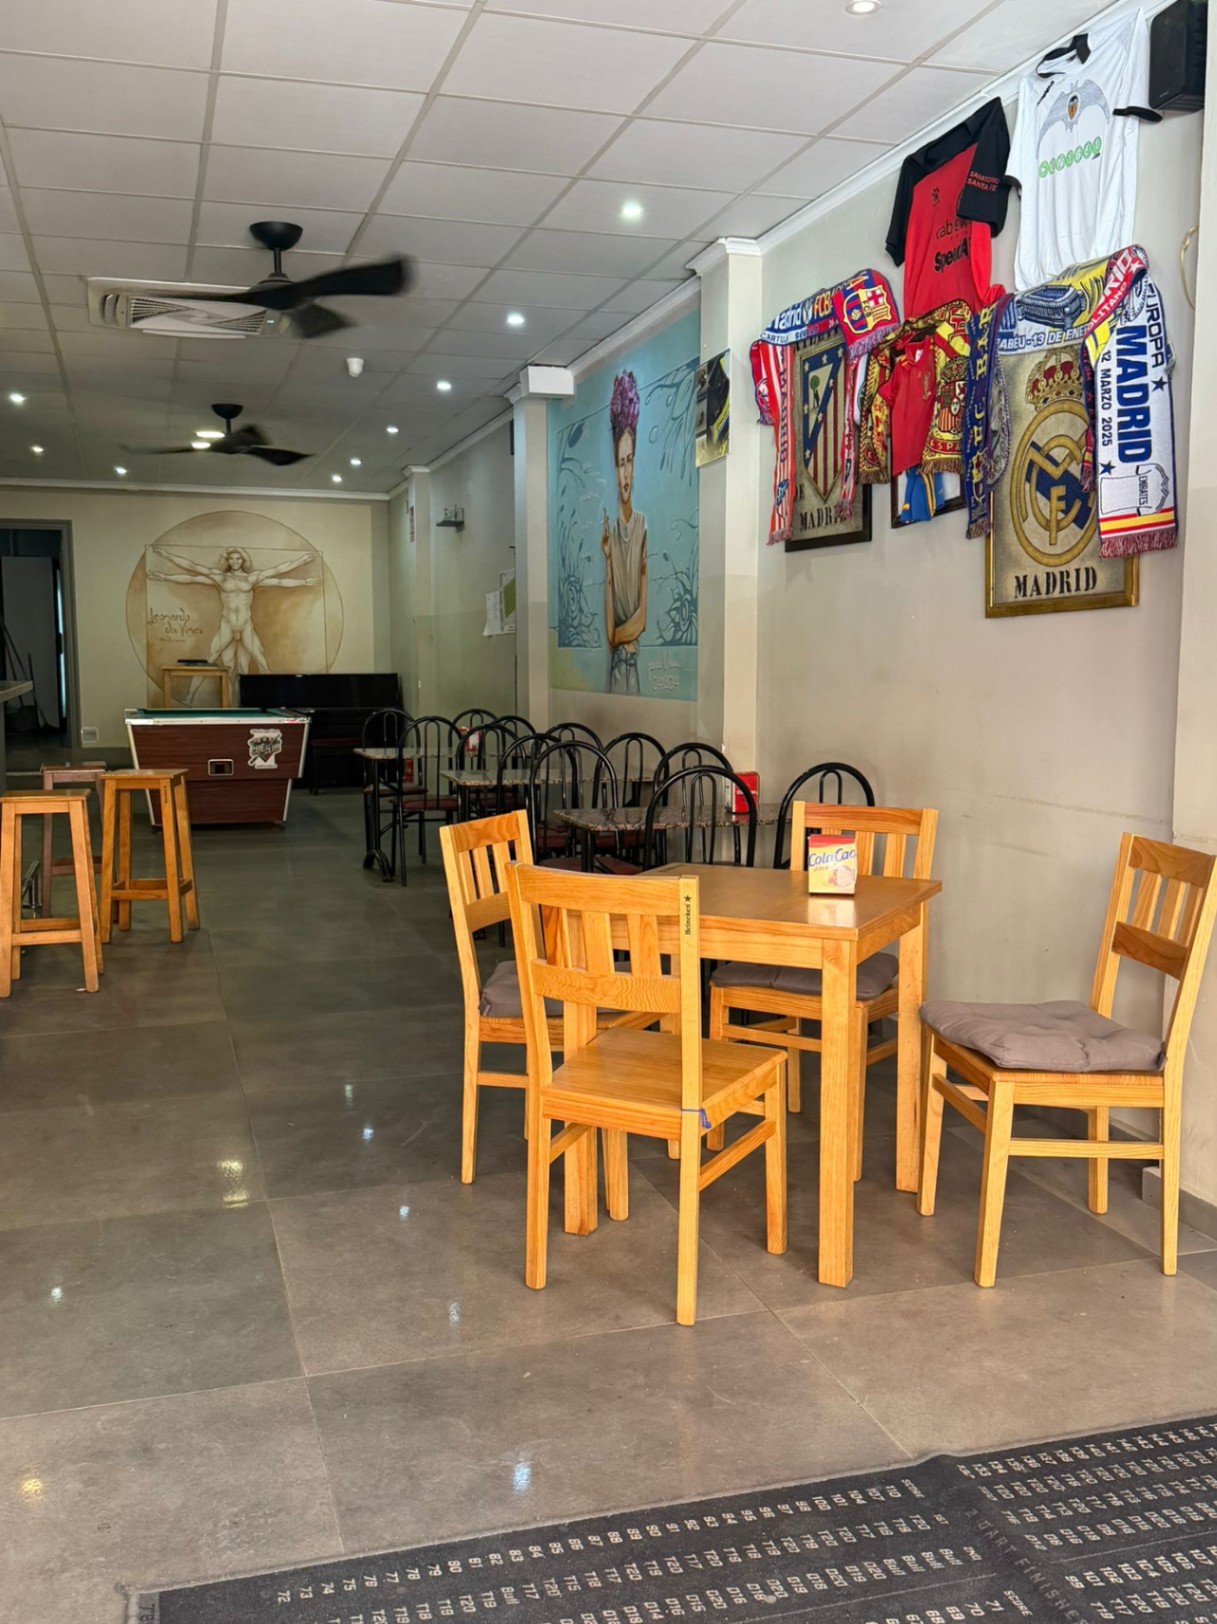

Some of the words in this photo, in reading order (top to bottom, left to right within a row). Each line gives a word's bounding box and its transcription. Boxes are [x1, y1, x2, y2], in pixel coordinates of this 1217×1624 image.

[1047, 330, 1063, 344] DE
[1101, 368, 1113, 411] MARZO
[1116, 324, 1153, 463] MADRID
[1101, 416, 1113, 447] 2025
[1014, 566, 1098, 599] MADRID
[684, 902, 692, 936] Heineken
[758, 1506, 776, 1519] 96
[780, 1536, 801, 1553] T20
[830, 1493, 849, 1507] 101
[855, 1523, 876, 1539] T17
[847, 1489, 868, 1505] 104
[873, 1521, 894, 1536] T18
[901, 1554, 926, 1572] Bull
[865, 1487, 886, 1501] 107
[892, 1517, 913, 1533] T19
[920, 1551, 945, 1569] Bull
[885, 1485, 902, 1498] 110
[909, 1514, 931, 1531] T20
[488, 1552, 504, 1566] 82
[587, 1535, 604, 1547] 87
[604, 1567, 623, 1584] T17
[702, 1515, 720, 1528] 93
[723, 1546, 743, 1563] T19
[721, 1512, 739, 1525] 94
[742, 1543, 762, 1559] T18
[766, 1578, 789, 1599] D20
[740, 1509, 758, 1522] 95
[761, 1540, 782, 1556] T19
[786, 1576, 809, 1594] D19
[777, 1503, 794, 1515] 97
[800, 1533, 820, 1549] T19
[824, 1568, 849, 1587] D20
[794, 1500, 812, 1512] 98
[817, 1529, 839, 1547] T20
[844, 1565, 868, 1583] D19
[811, 1495, 832, 1511] 100
[836, 1526, 858, 1543] T20
[862, 1561, 887, 1580] D20
[1171, 1552, 1196, 1570] 106
[1188, 1548, 1215, 1566] 107
[342, 1578, 357, 1591] 75
[363, 1574, 379, 1588] 76
[385, 1571, 400, 1584] 77
[468, 1557, 484, 1569] 81
[480, 1590, 497, 1609] T19
[508, 1549, 525, 1563] 83
[522, 1582, 541, 1600] T17
[528, 1545, 546, 1559] 84
[543, 1577, 563, 1598] T20
[548, 1541, 565, 1555] 85
[563, 1574, 582, 1592] T15
[567, 1538, 585, 1551] 86
[583, 1570, 603, 1588] T18
[606, 1531, 624, 1544] 88
[624, 1562, 643, 1581] T20
[643, 1601, 665, 1620] D14
[626, 1528, 644, 1541] 89
[644, 1559, 663, 1576] T19
[664, 1597, 686, 1616] D16
[645, 1524, 663, 1537] 90
[664, 1555, 684, 1574] T20
[685, 1594, 707, 1613] D15
[665, 1522, 681, 1533] 91
[684, 1553, 704, 1570] T17
[705, 1589, 728, 1610] D20
[683, 1519, 701, 1531] 92
[703, 1549, 724, 1567] T20
[725, 1586, 748, 1605] D16
[1117, 1562, 1143, 1581] 103
[1146, 1590, 1172, 1609] T19
[1135, 1558, 1162, 1578] 104
[1162, 1586, 1191, 1606] T20
[1153, 1555, 1179, 1574] 105
[1181, 1582, 1211, 1602] T20
[277, 1589, 291, 1604] 72
[299, 1585, 314, 1599] 73
[320, 1582, 335, 1595] 74
[405, 1567, 422, 1580] 78
[415, 1602, 433, 1621] T18
[427, 1563, 443, 1577] 79
[437, 1598, 455, 1616] T19
[458, 1594, 477, 1613] T20
[964, 1601, 986, 1617] 70
[985, 1599, 1005, 1612] 71
[1003, 1590, 1033, 1617] SCORE
[1064, 1575, 1085, 1589] 99
[1090, 1601, 1116, 1620] T19
[1082, 1570, 1106, 1587] 101
[1109, 1597, 1135, 1616] T17
[1099, 1566, 1125, 1584] 102
[1126, 1593, 1154, 1614] T20
[945, 1606, 966, 1621] 69
